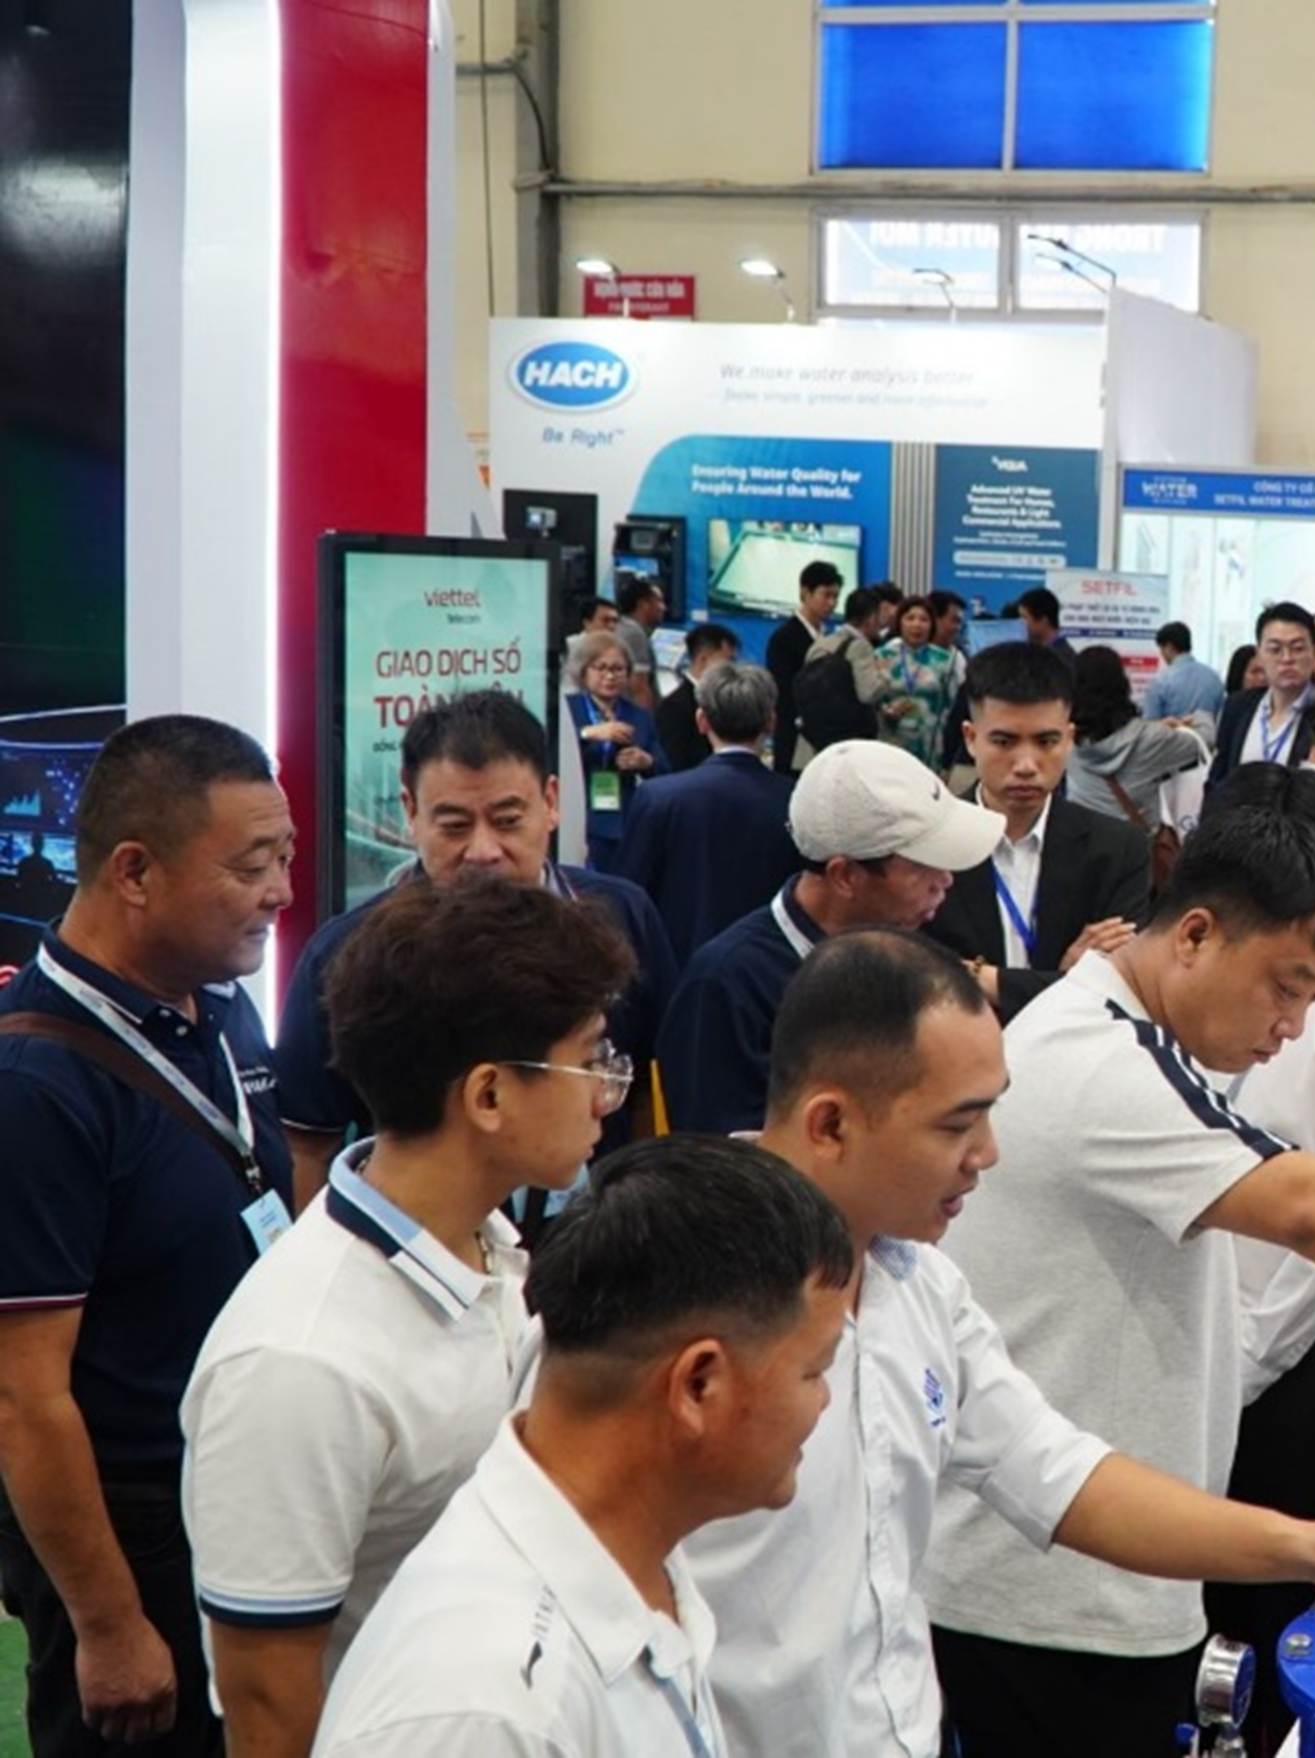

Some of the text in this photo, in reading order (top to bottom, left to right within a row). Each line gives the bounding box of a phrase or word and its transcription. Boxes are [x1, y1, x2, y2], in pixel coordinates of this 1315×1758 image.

[524, 360, 623, 389] HACH
[542, 427, 564, 443] Be
[749, 466, 789, 480] Water
[791, 467, 839, 484] Quality
[840, 468, 862, 482] for
[691, 480, 734, 495] People
[736, 483, 784, 496] Around
[786, 484, 808, 497] the
[1141, 481, 1198, 499] WATER
[424, 587, 481, 607] viettel
[376, 649, 433, 678] GIAO
[492, 636, 522, 674] SỐ
